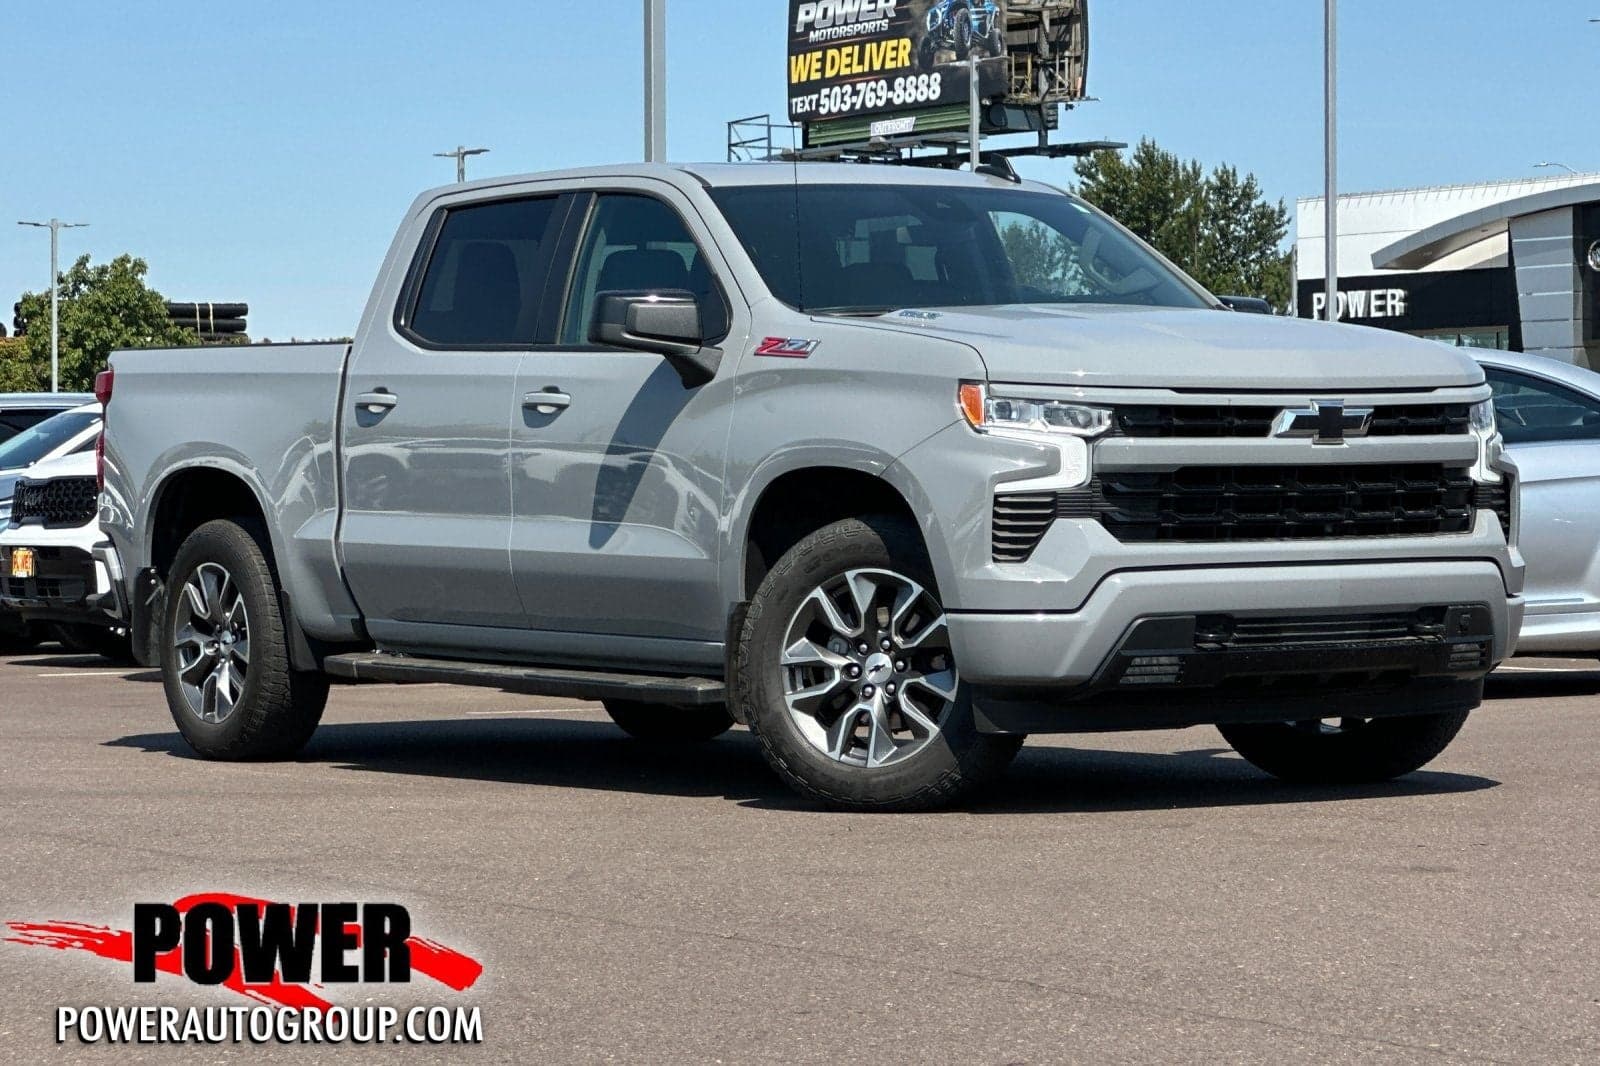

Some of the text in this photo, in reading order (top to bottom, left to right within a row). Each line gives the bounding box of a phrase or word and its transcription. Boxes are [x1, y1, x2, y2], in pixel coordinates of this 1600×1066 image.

[796, 0, 896, 32] POWER
[809, 19, 889, 43] MOTORSPORTS
[790, 37, 912, 84] WE DELIVER
[791, 72, 942, 115] TEXT 503-769-8888
[753, 336, 822, 359] Z71
